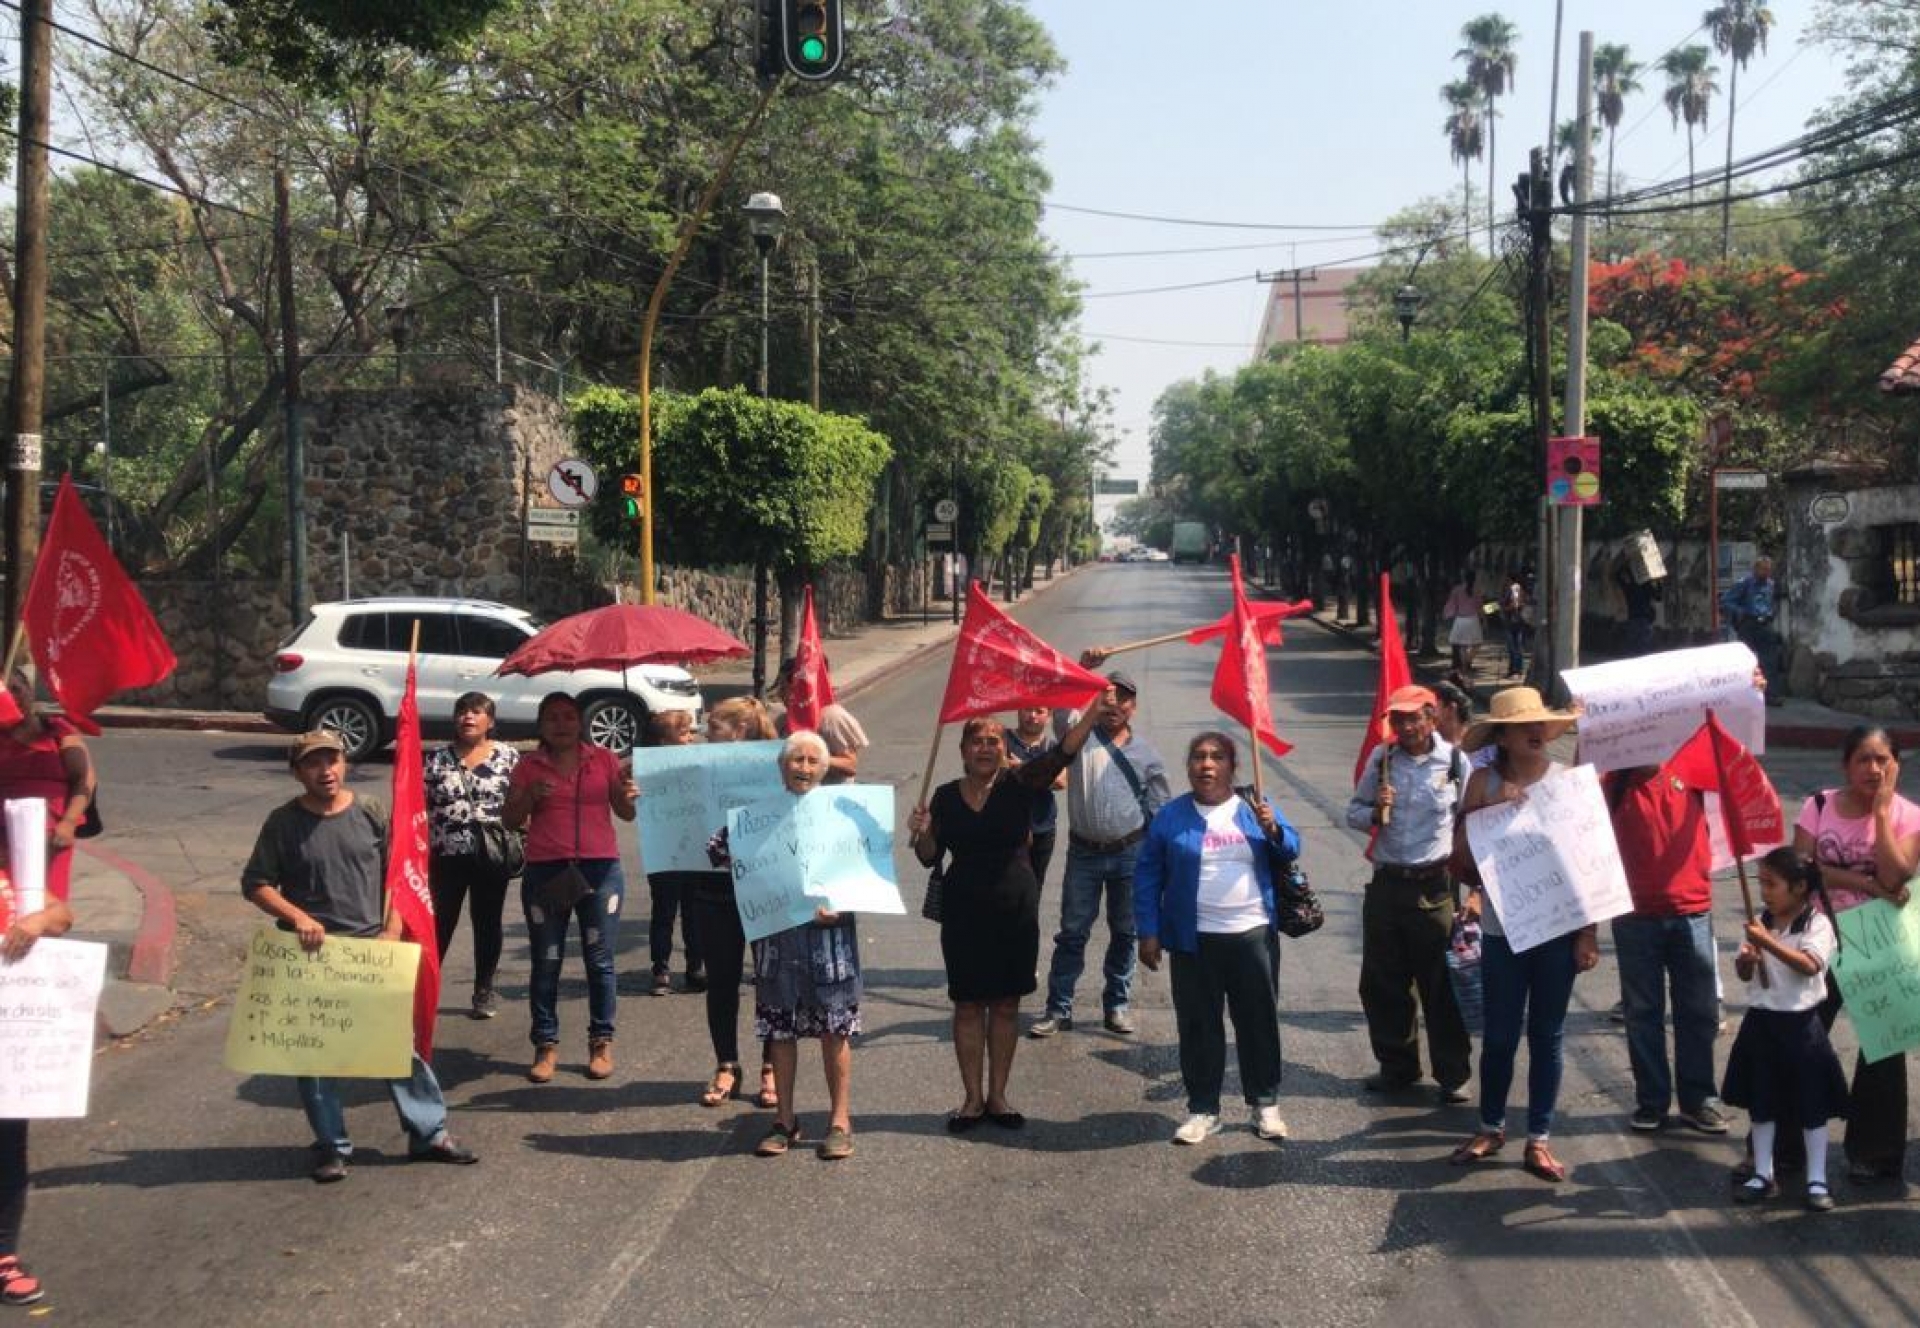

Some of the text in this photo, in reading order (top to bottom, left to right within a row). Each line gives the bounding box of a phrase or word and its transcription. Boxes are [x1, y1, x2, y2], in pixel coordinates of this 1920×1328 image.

[342, 944, 393, 968] Salud
[278, 1011, 298, 1026] de
[310, 1012, 353, 1033] Mayo
